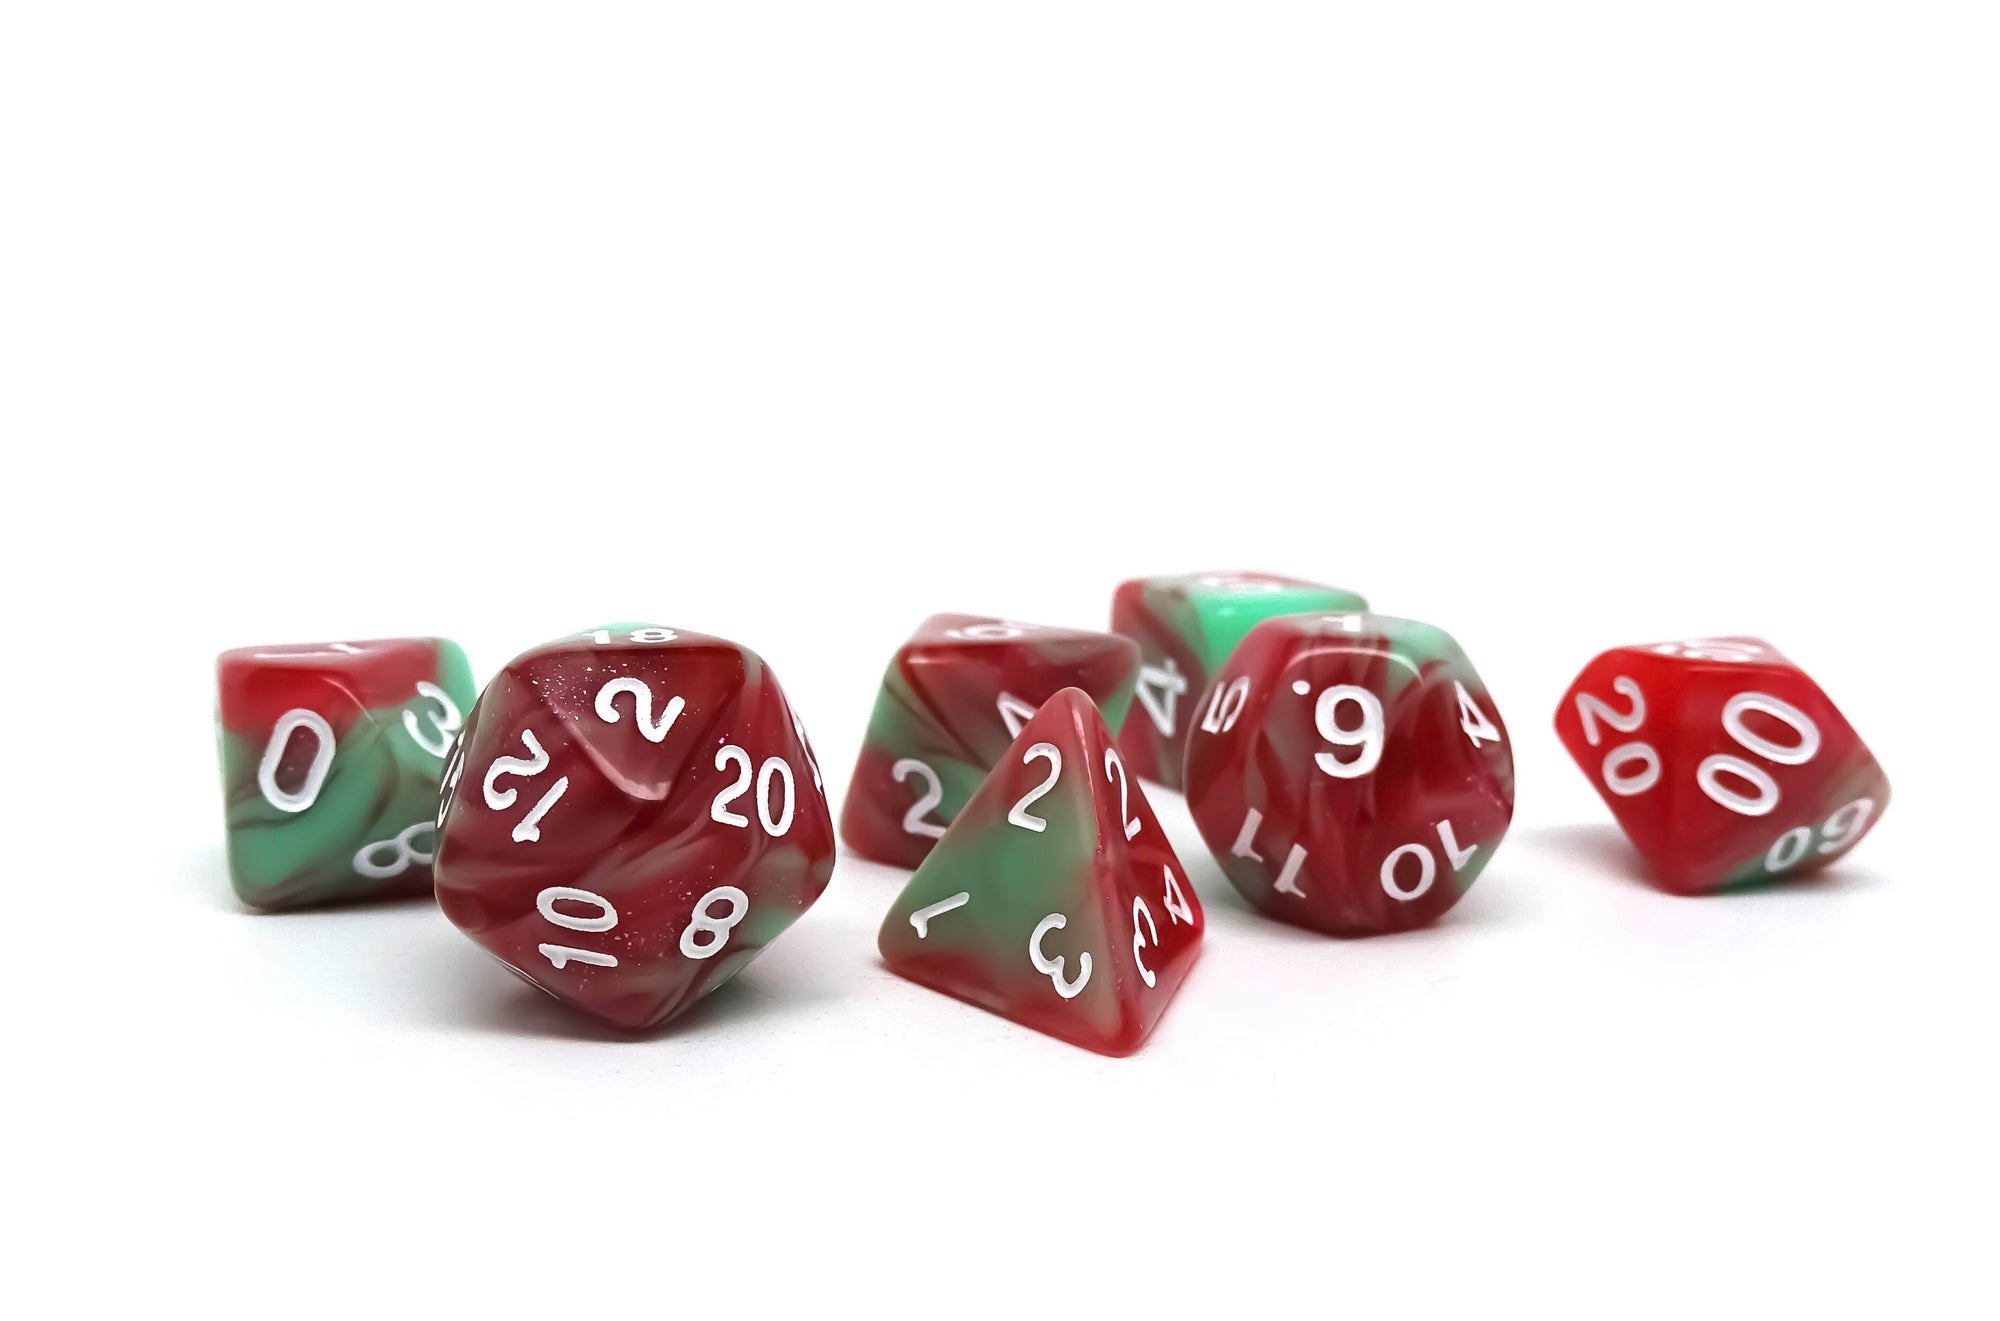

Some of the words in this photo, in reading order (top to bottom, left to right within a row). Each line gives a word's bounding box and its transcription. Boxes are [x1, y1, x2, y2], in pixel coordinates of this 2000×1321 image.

[582, 628, 678, 645] 18
[402, 681, 462, 759] 3
[594, 676, 686, 743] 2
[1135, 658, 1188, 739] 4
[1201, 675, 1251, 734] 5
[1454, 680, 1500, 749] 4
[1575, 676, 1662, 797] 20
[258, 708, 336, 813] 0
[482, 728, 569, 843] 12
[711, 744, 795, 838] 20
[1007, 742, 1062, 833] 2
[1104, 747, 1142, 842] 2
[1696, 691, 1822, 817] 00
[892, 758, 948, 839] 2
[353, 821, 436, 879] 8
[1231, 808, 1308, 899] 11
[1380, 819, 1478, 901] 10
[536, 885, 619, 969] 10
[679, 885, 749, 959] 8
[909, 891, 970, 939] 1
[1163, 864, 1194, 926] 4
[1029, 912, 1093, 999] 3
[1132, 895, 1160, 989] 3
